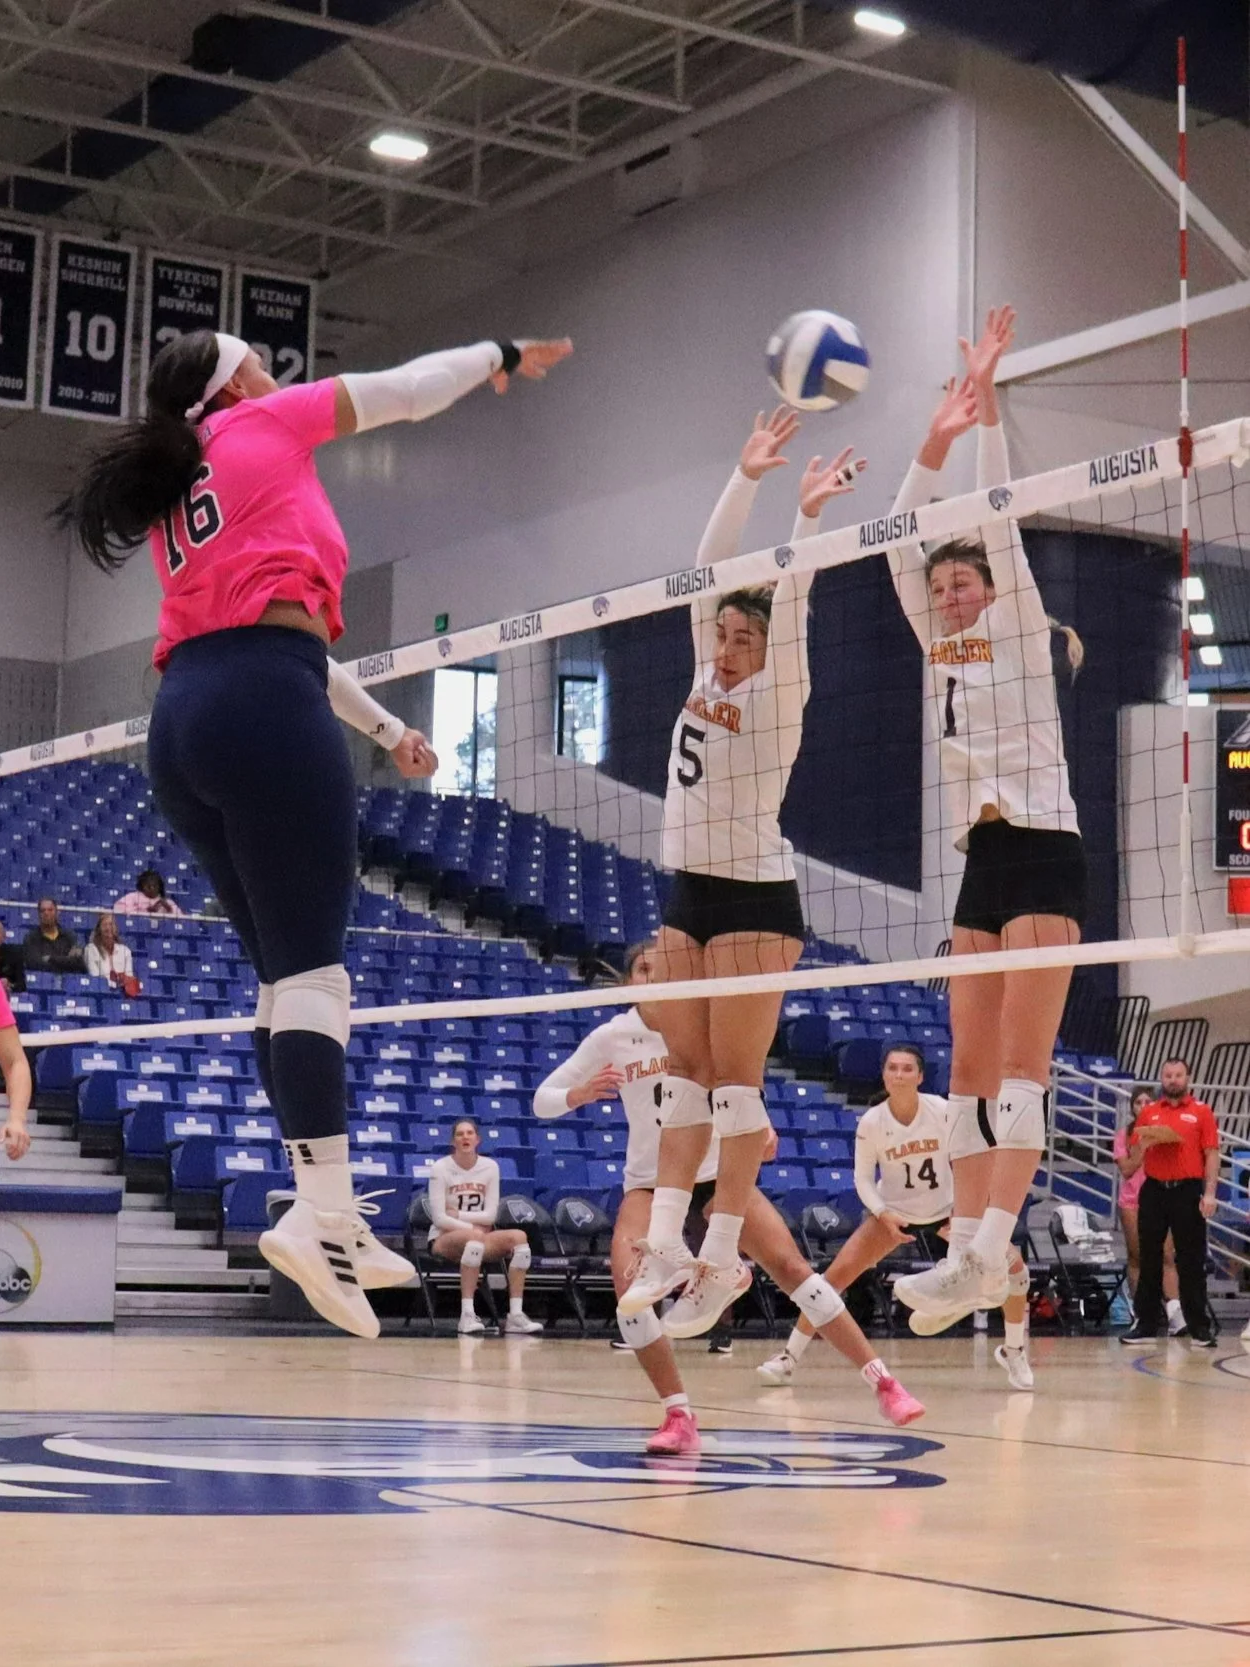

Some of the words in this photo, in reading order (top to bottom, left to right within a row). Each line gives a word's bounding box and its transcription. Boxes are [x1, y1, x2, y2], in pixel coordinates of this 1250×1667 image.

[60, 268, 126, 292] SHERRILL
[158, 297, 214, 317] BOWMAN
[255, 304, 294, 321] MANN
[65, 309, 117, 362] 10
[91, 390, 118, 405] 2017
[1088, 446, 1159, 487] AUGUSTA
[161, 461, 225, 577] 16
[859, 510, 919, 549] AUGUSTA
[664, 566, 716, 600] AUGUSTA
[499, 613, 543, 643] AUGUSTA
[356, 651, 395, 679] AUGUSTA
[944, 677, 957, 738] 1
[677, 723, 706, 787] 5
[902, 1157, 939, 1190] 14
[458, 1193, 481, 1212] 12
